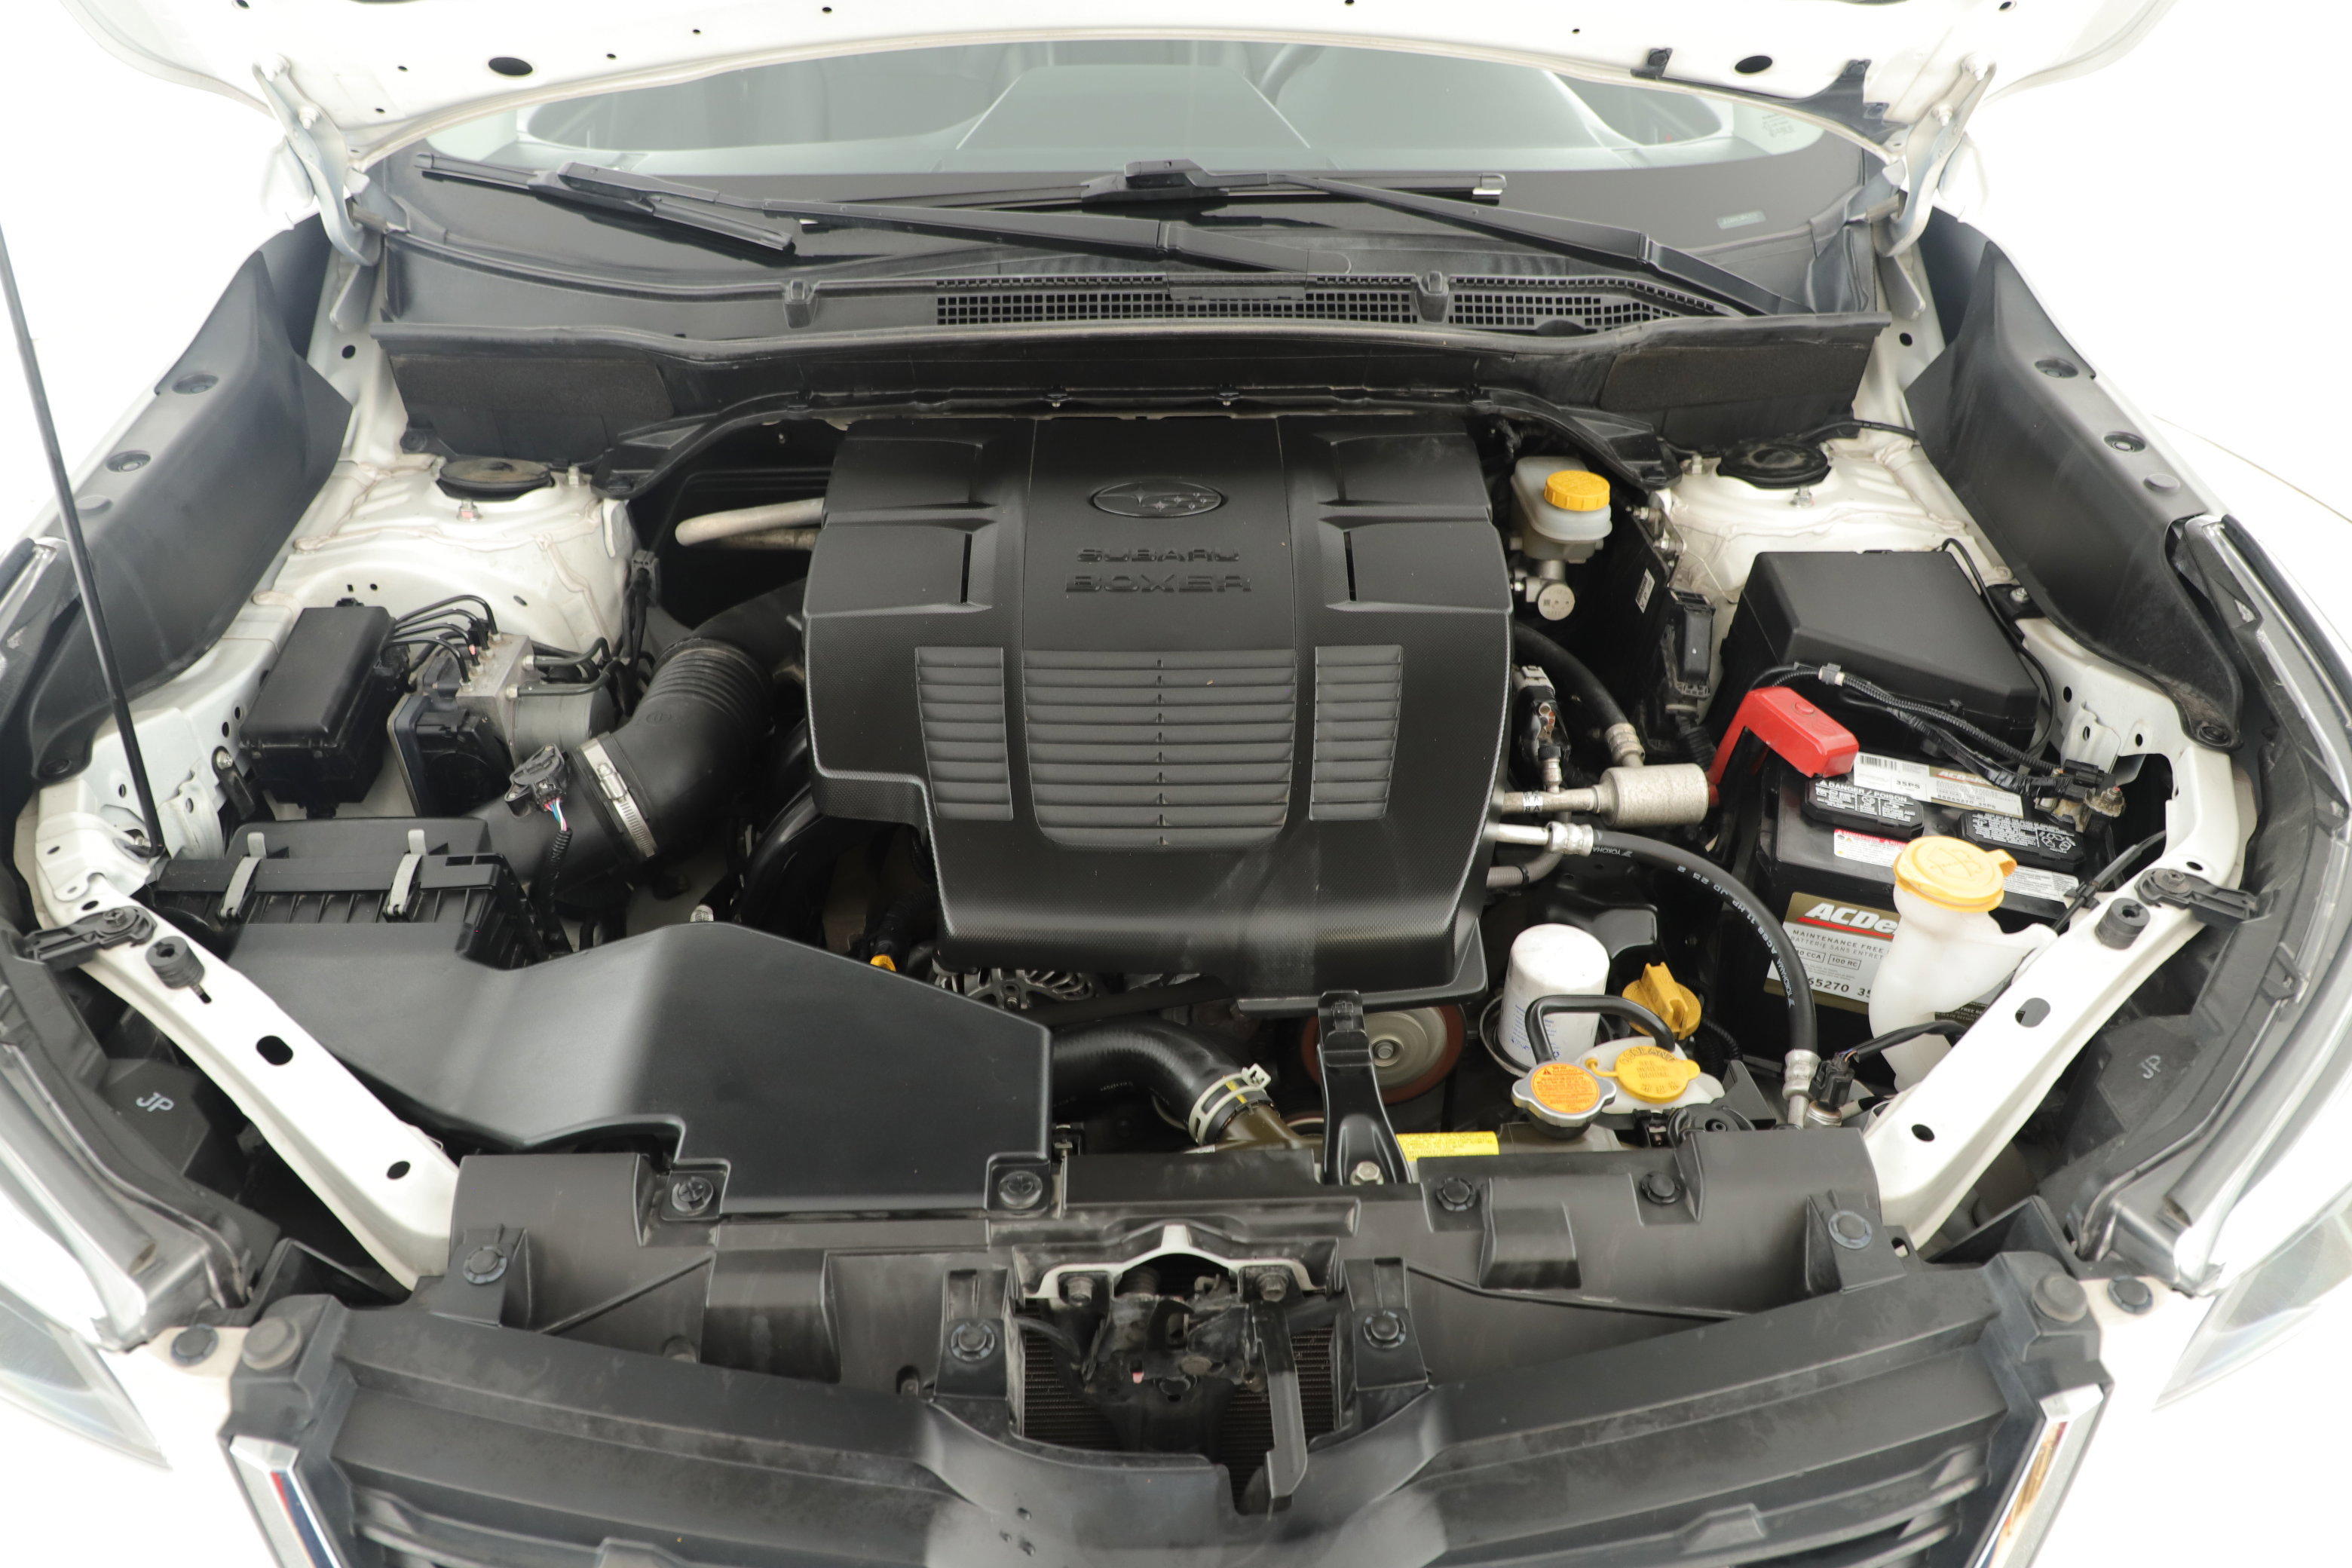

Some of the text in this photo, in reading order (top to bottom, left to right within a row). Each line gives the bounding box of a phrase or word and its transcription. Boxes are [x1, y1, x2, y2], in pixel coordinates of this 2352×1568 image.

[1076, 548, 1240, 562] SUBARU
[1065, 574, 1252, 593] BOXER
[1828, 781, 1864, 795] DANGER
[1874, 792, 1907, 803] POISON
[1804, 902, 1898, 933] ACDe
[1790, 936, 1827, 949] BATTERIE
[1830, 945, 1851, 954] SANS
[1793, 929, 1883, 954] MAINTENANCE FREE
[1848, 960, 1859, 968] RC
[136, 1091, 174, 1112] JP
